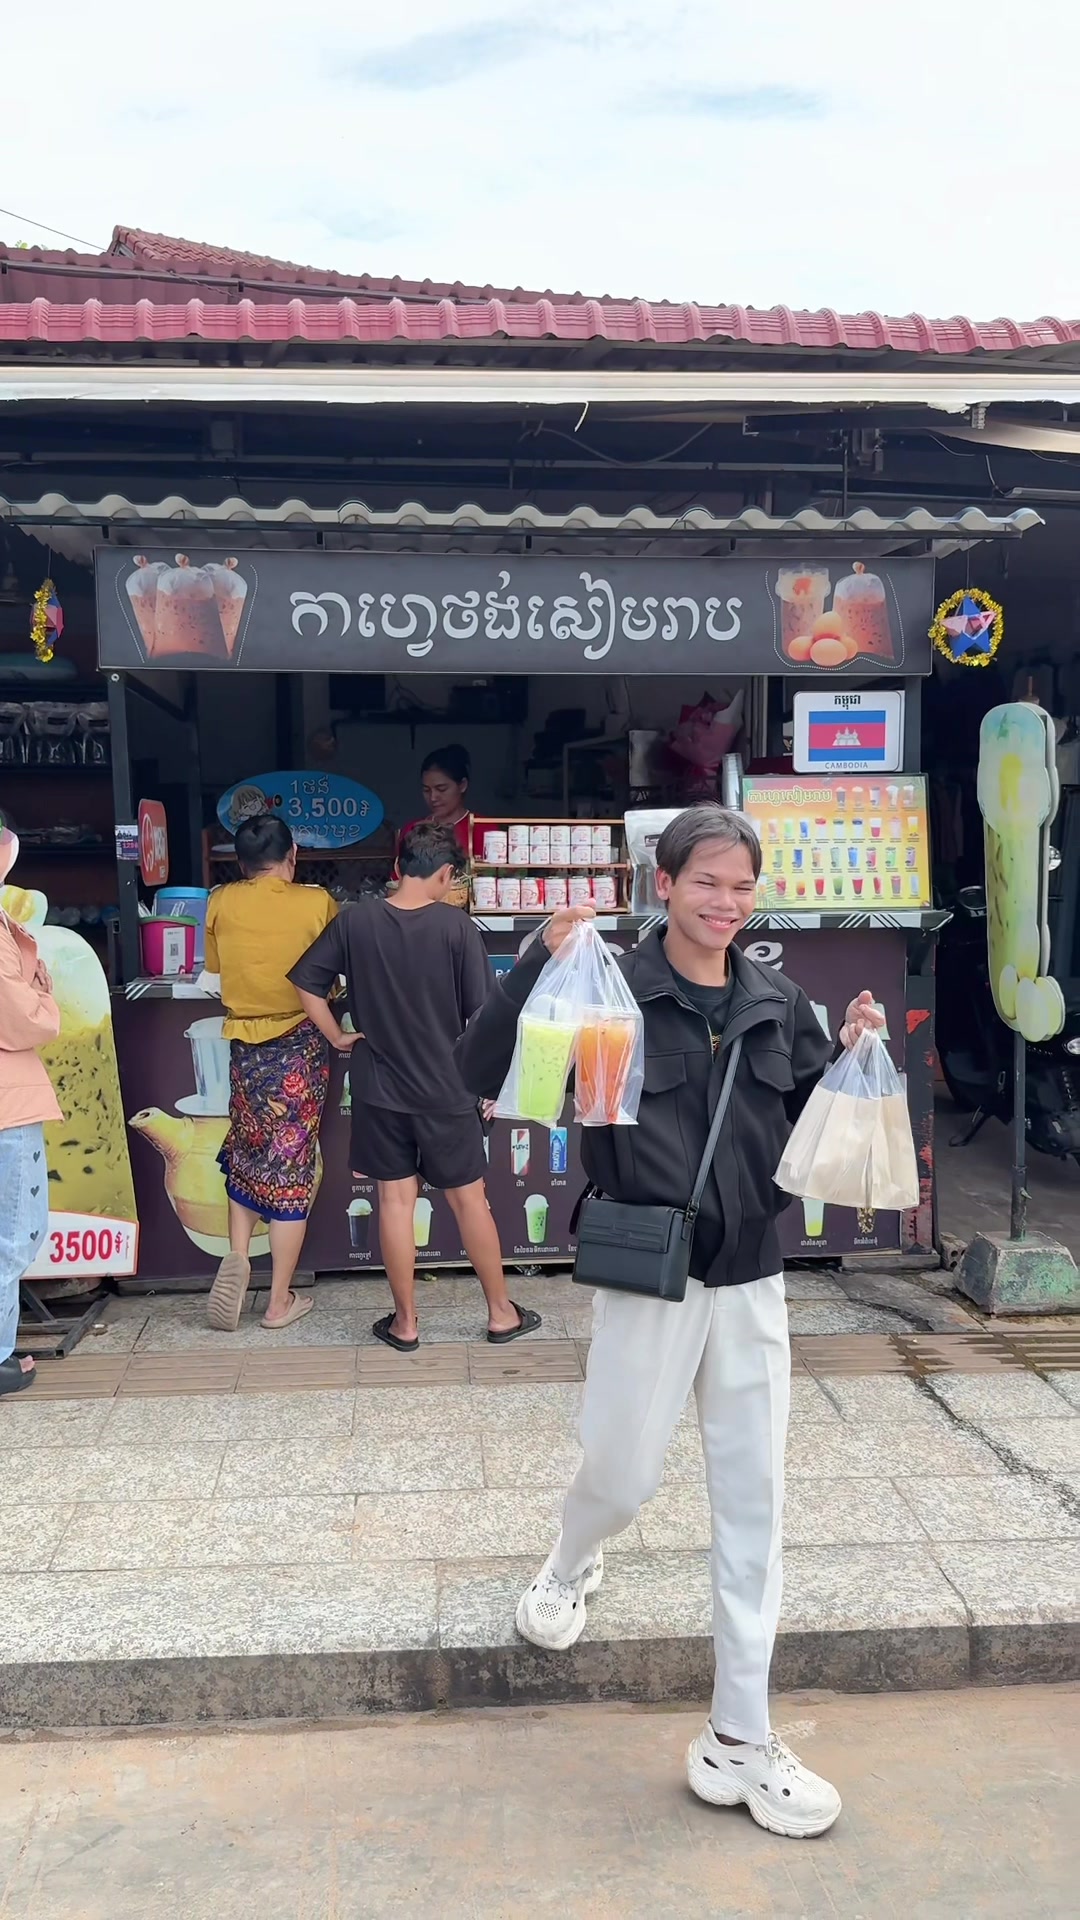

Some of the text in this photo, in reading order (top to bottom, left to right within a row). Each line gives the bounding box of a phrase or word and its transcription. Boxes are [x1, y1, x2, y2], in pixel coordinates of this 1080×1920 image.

[290, 570, 742, 660] កាហ្វេថង់សៀមរាប
[834, 695, 861, 710] កម្ពុជា
